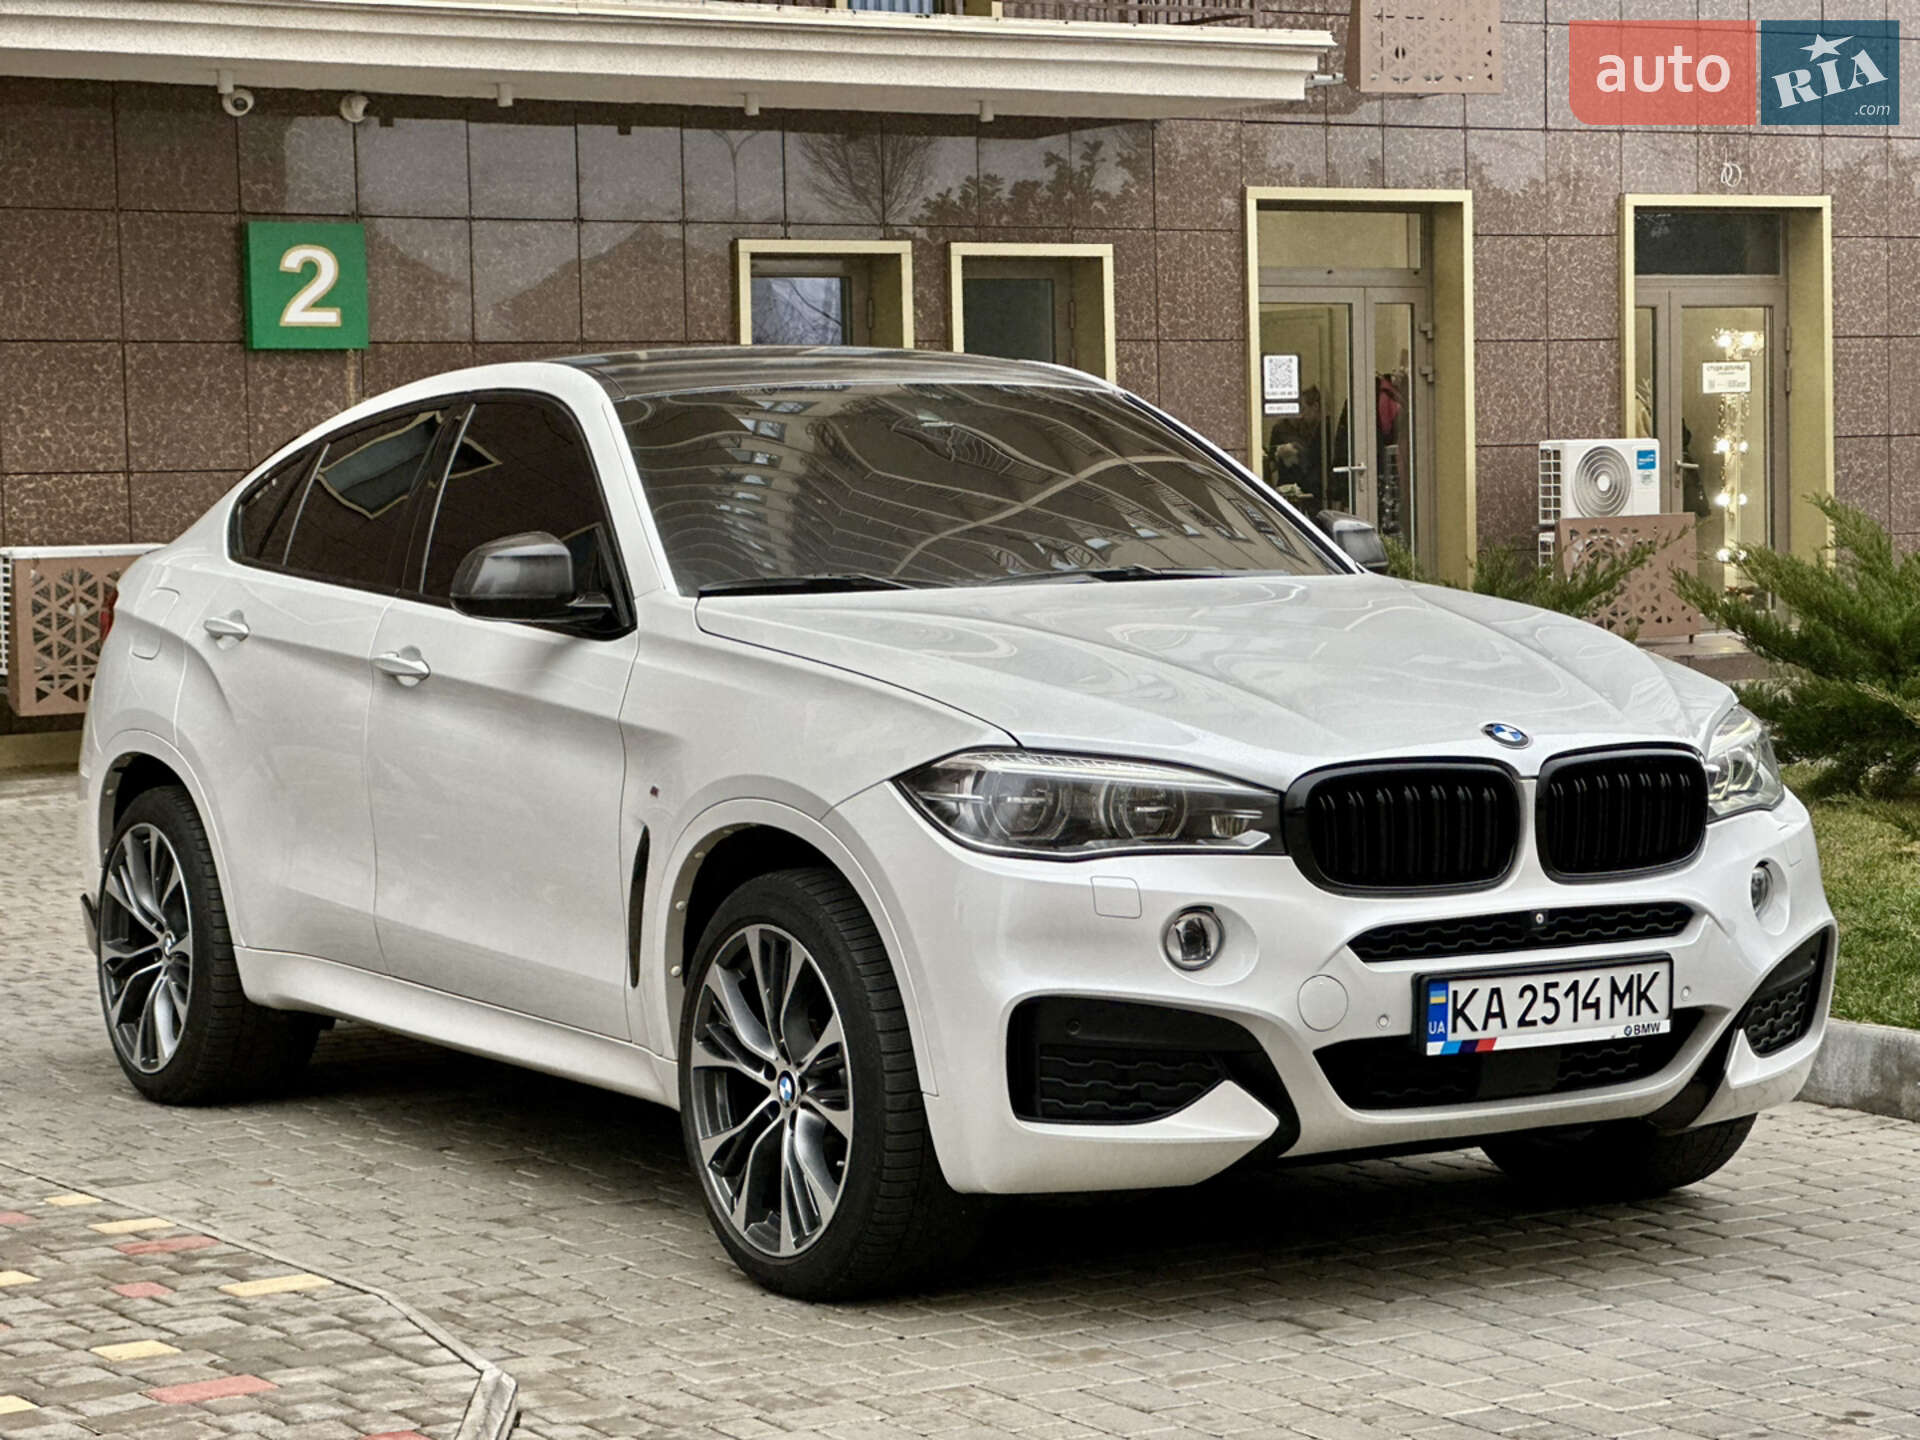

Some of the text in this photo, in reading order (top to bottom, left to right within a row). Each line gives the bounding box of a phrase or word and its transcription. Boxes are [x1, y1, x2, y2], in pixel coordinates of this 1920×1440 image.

[279, 244, 342, 328] 2
[1516, 977, 1601, 1029] 2514
[1428, 1020, 1447, 1035] UA
[1634, 1022, 1661, 1036] BMW
